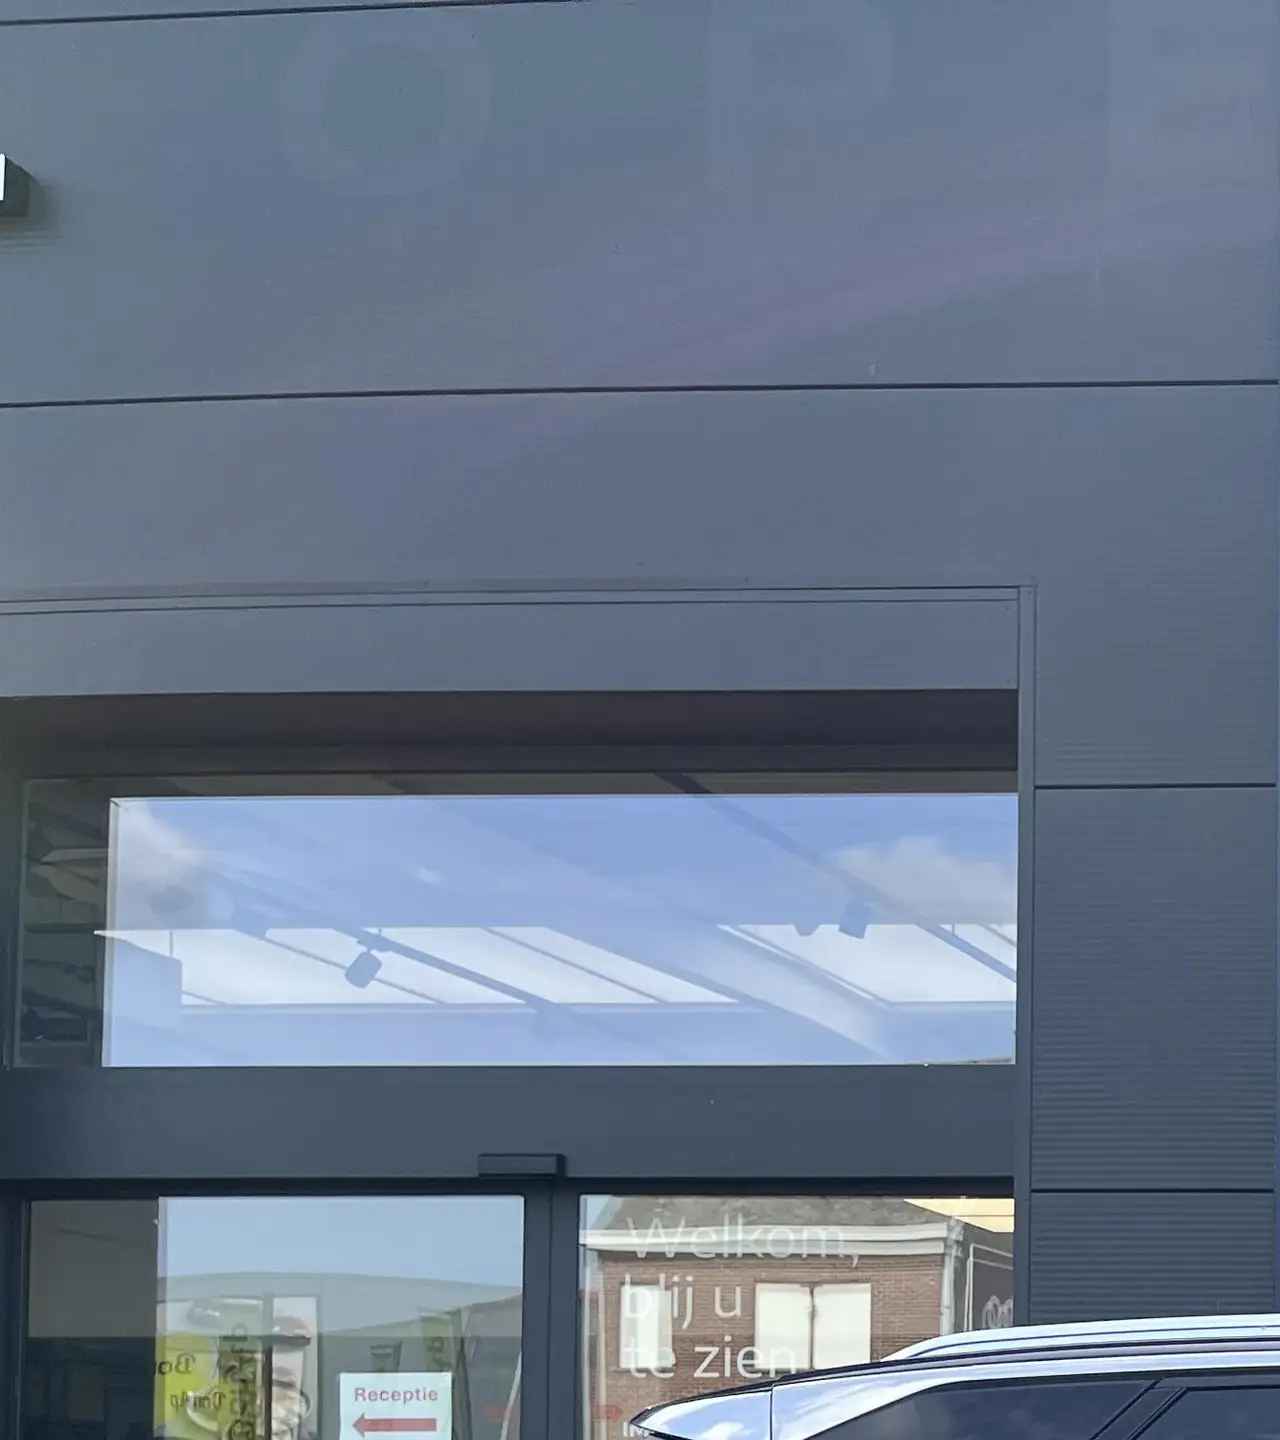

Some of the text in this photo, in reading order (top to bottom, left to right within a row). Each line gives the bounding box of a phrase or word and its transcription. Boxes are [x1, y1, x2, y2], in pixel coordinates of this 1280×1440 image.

[627, 1213, 860, 1268] Welkom,
[622, 1273, 743, 1330] blij u
[621, 1337, 677, 1378] te
[354, 1387, 438, 1405] Receptie
